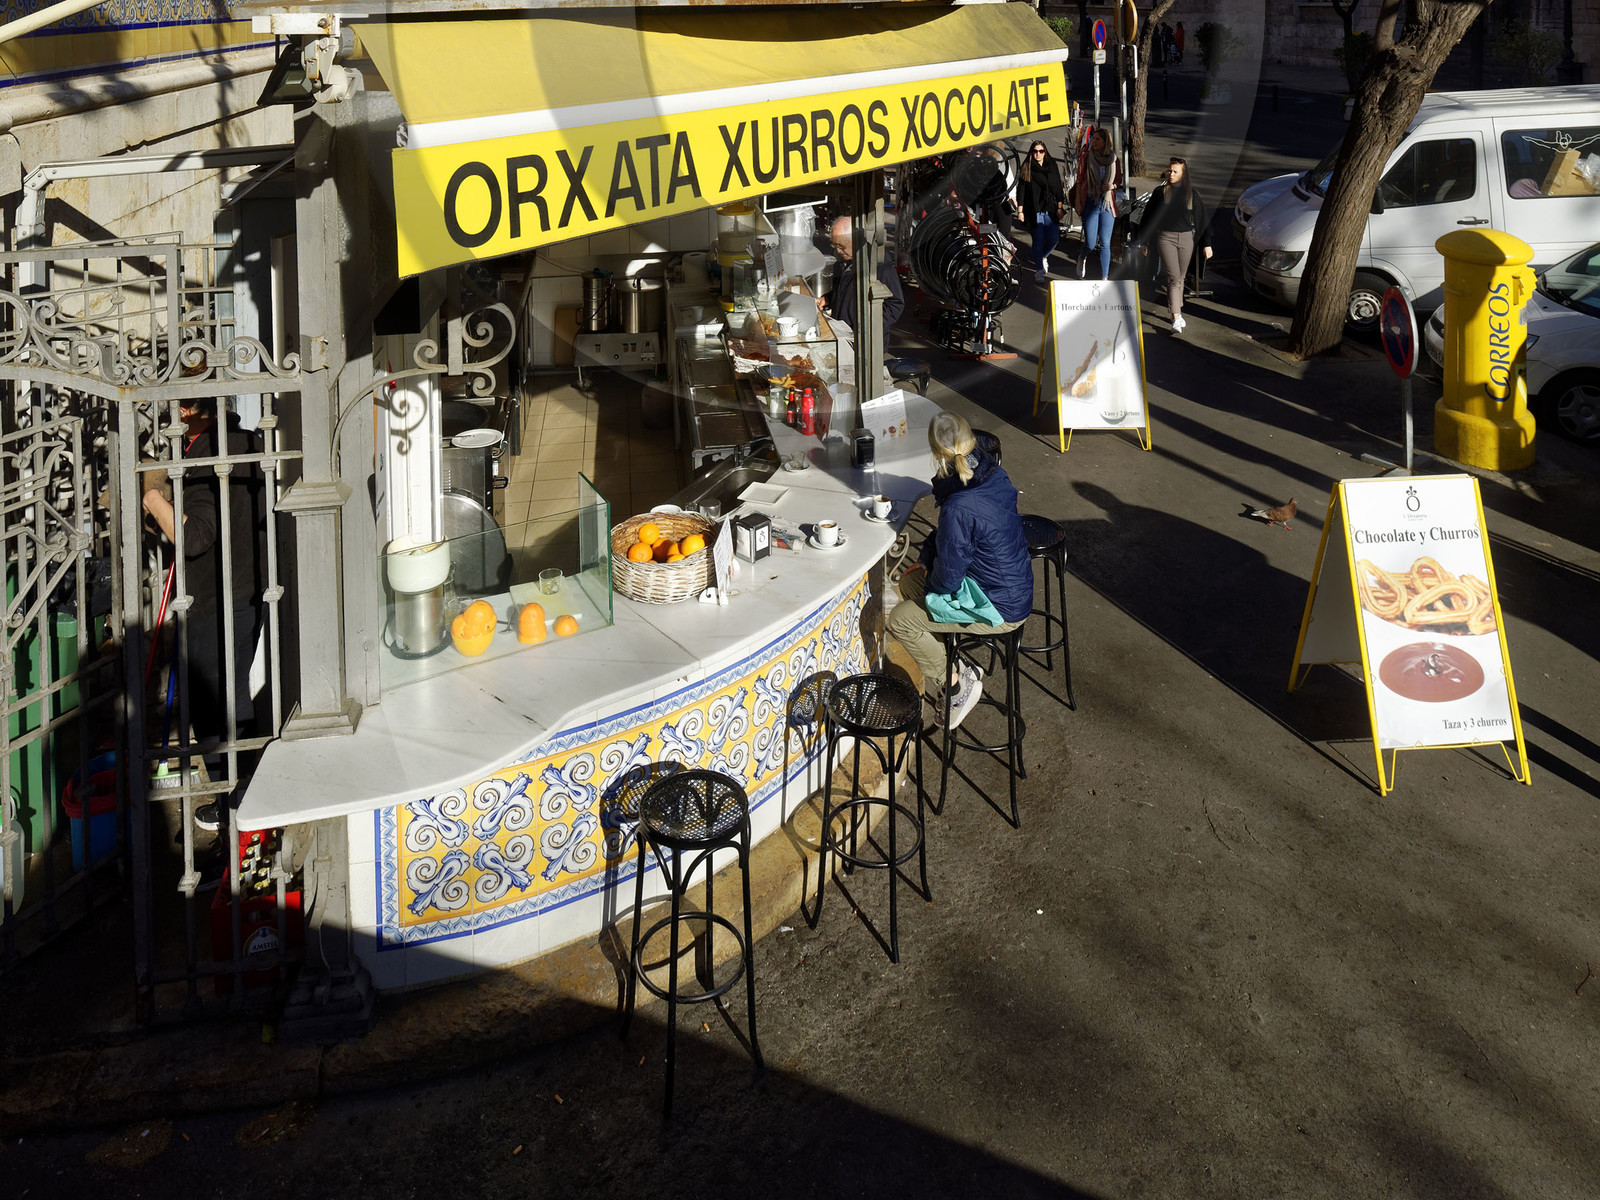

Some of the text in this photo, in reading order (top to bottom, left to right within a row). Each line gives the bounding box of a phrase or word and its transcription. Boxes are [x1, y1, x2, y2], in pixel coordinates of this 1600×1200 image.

[443, 75, 1052, 248] ORXATA XURROS XOCOLATE
[1061, 303, 1096, 311] Horchata
[1104, 303, 1133, 311] Fartons
[1484, 281, 1511, 402] CORREOS
[1354, 526, 1480, 545] Chocolate y Churros
[1442, 716, 1507, 731] Taza y 3 churros
[252, 940, 278, 951] AMSTEL
